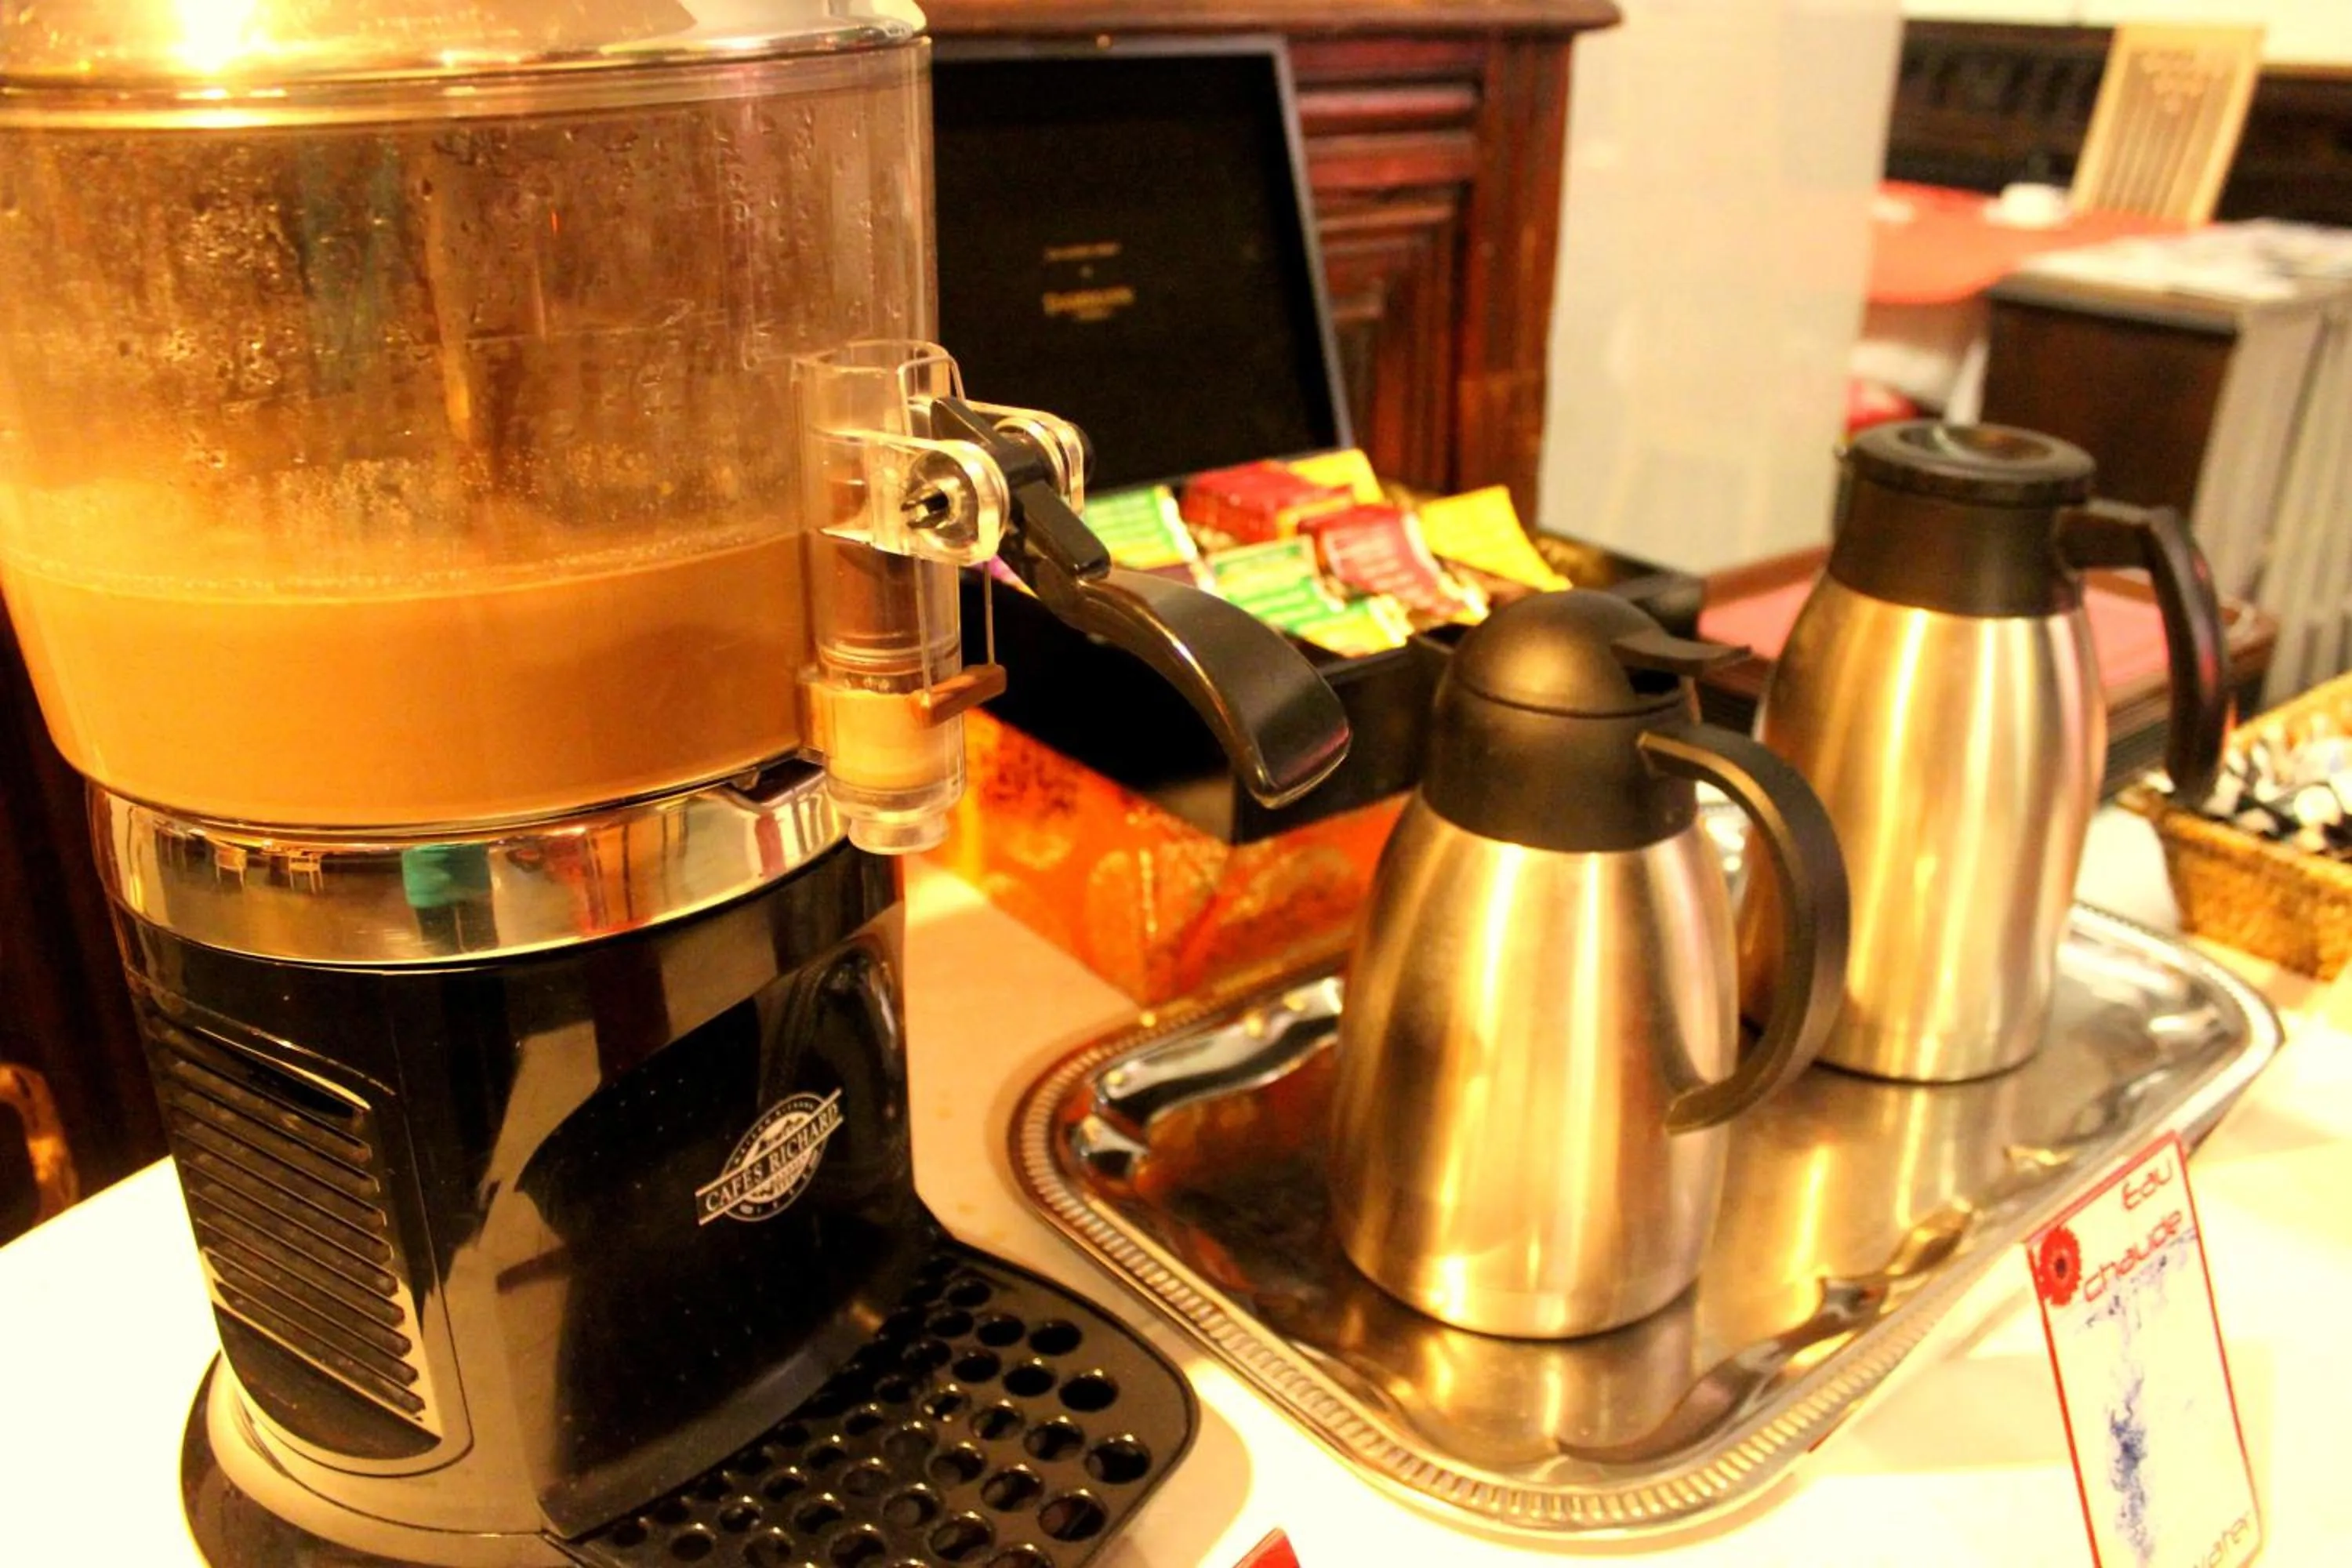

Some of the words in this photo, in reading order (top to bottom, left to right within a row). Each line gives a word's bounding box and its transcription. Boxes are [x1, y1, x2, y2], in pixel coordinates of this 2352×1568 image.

[768, 1103, 839, 1171] RICHARD
[2122, 1157, 2173, 1210] Eau
[2084, 1210, 2183, 1303] chaude
